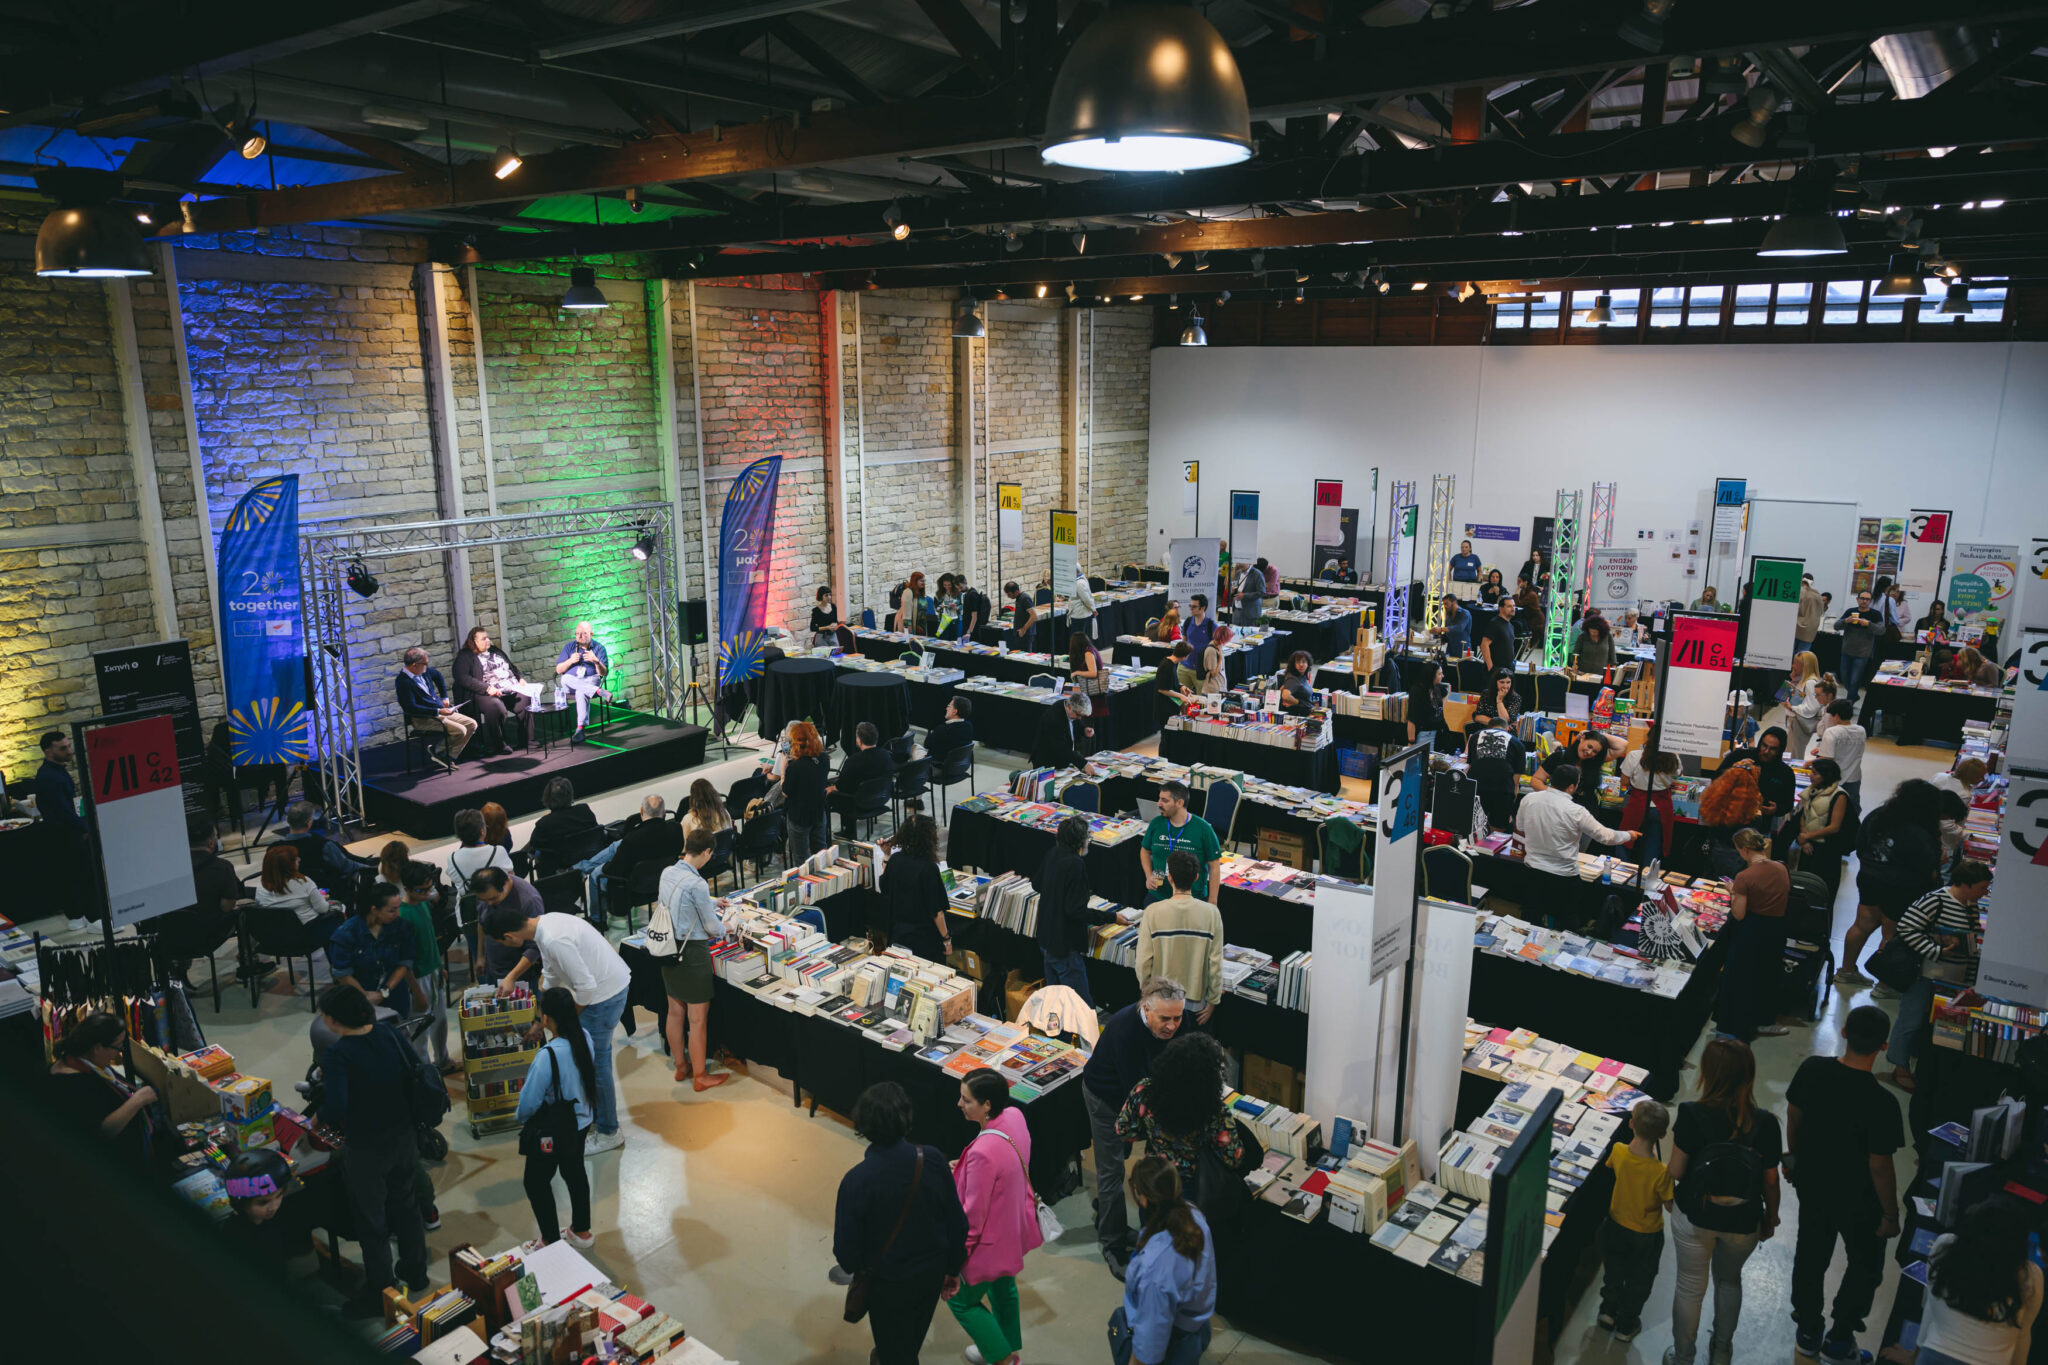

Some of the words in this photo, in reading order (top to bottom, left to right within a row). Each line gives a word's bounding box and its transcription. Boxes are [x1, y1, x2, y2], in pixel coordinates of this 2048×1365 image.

[1783, 580, 1792, 590] C
[229, 599, 299, 613] together
[1711, 643, 1723, 655] C
[104, 661, 130, 673] Σκηνή
[1709, 655, 1727, 668] 51
[146, 752, 161, 767] C
[149, 766, 173, 785] 42
[1404, 794, 1413, 810] C
[1403, 810, 1416, 828] 46
